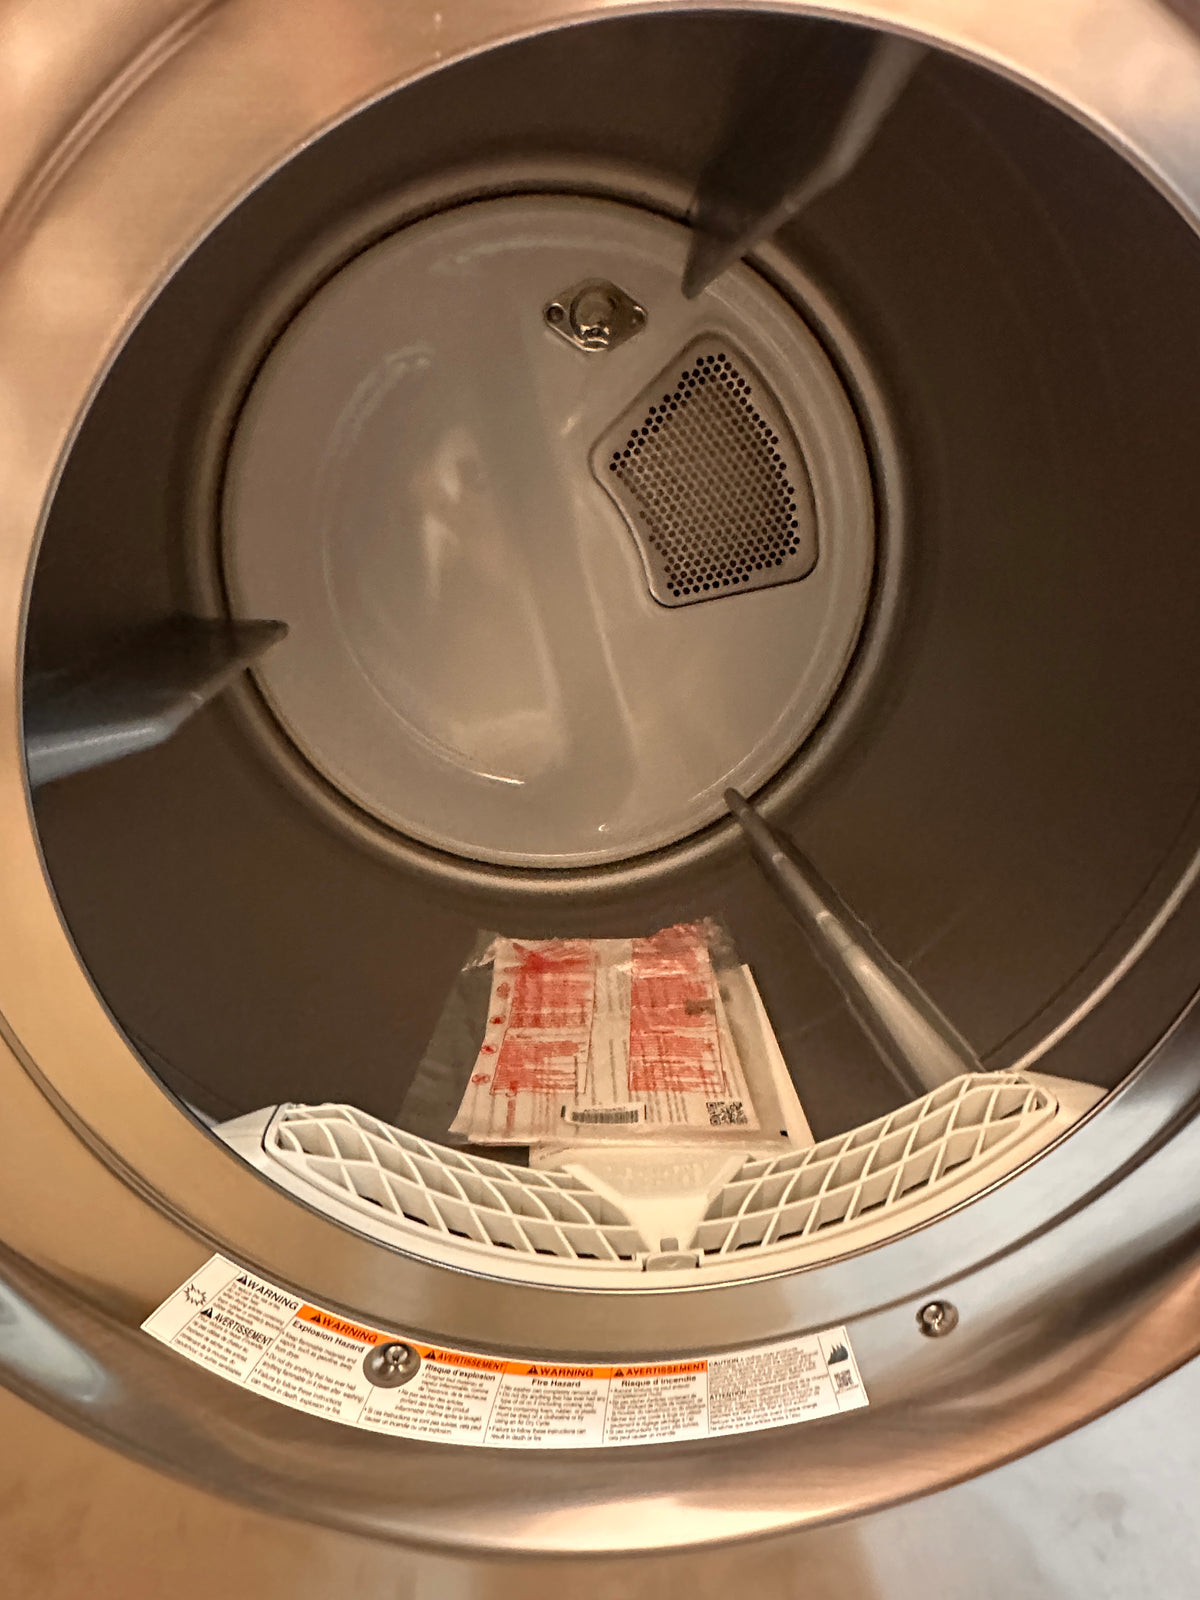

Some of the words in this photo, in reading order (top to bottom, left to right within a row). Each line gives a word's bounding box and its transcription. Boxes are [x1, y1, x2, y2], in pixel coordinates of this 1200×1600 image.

[246, 1279, 299, 1311] WARNING
[215, 1313, 273, 1346] AVERTISSEMENT
[293, 1320, 333, 1342] Explosion
[335, 1335, 365, 1353] Hazard
[323, 1316, 378, 1343] WARNING
[438, 1352, 504, 1370] AVERTISSEMENT
[626, 1363, 705, 1376] AVERTISSEMENT
[425, 1364, 452, 1376] Risque
[452, 1368, 496, 1382] d'explosion
[540, 1368, 594, 1377] WARNING
[551, 1380, 581, 1388] Hazard
[621, 1380, 651, 1388] Risque
